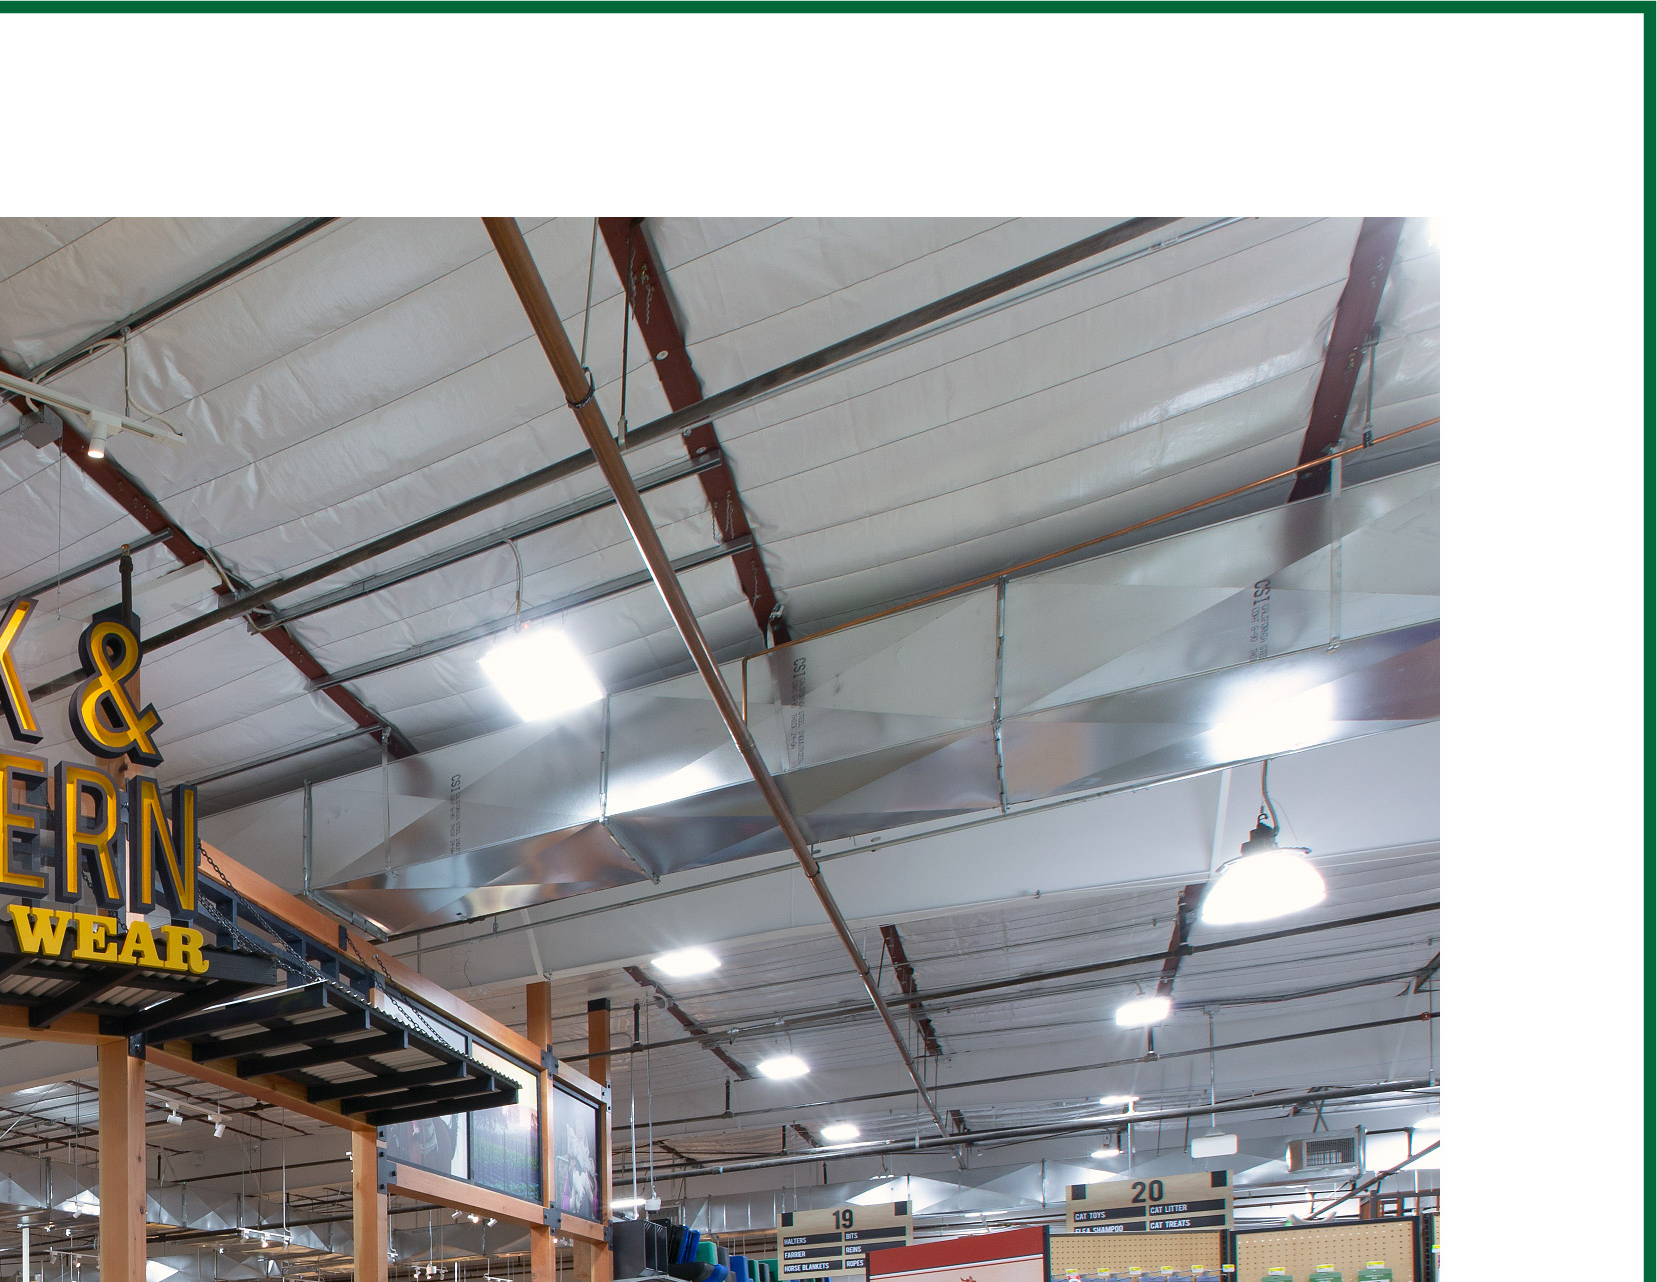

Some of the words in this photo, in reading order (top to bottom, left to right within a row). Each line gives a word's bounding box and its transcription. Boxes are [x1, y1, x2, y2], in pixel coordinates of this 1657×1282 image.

[1253, 579, 1270, 606] CSI
[793, 657, 806, 678] CSI
[69, 609, 164, 768] &
[451, 774, 461, 793] CSI
[7, 904, 209, 975] WEAR
[1131, 1179, 1163, 1203] 20
[1074, 1213, 1087, 1221] CAT
[1089, 1211, 1106, 1219] TOYS
[1150, 1206, 1162, 1214] CAT
[1164, 1204, 1187, 1212] LITTER
[832, 1209, 854, 1229] 19
[1150, 1221, 1163, 1229] CAT
[1165, 1219, 1191, 1228] TREATS
[784, 1237, 807, 1245] HALTERS
[784, 1250, 806, 1259] FARRIER
[784, 1264, 801, 1272] HORSE
[802, 1262, 830, 1271] BLANKETS
[846, 1259, 863, 1267] ROPES
